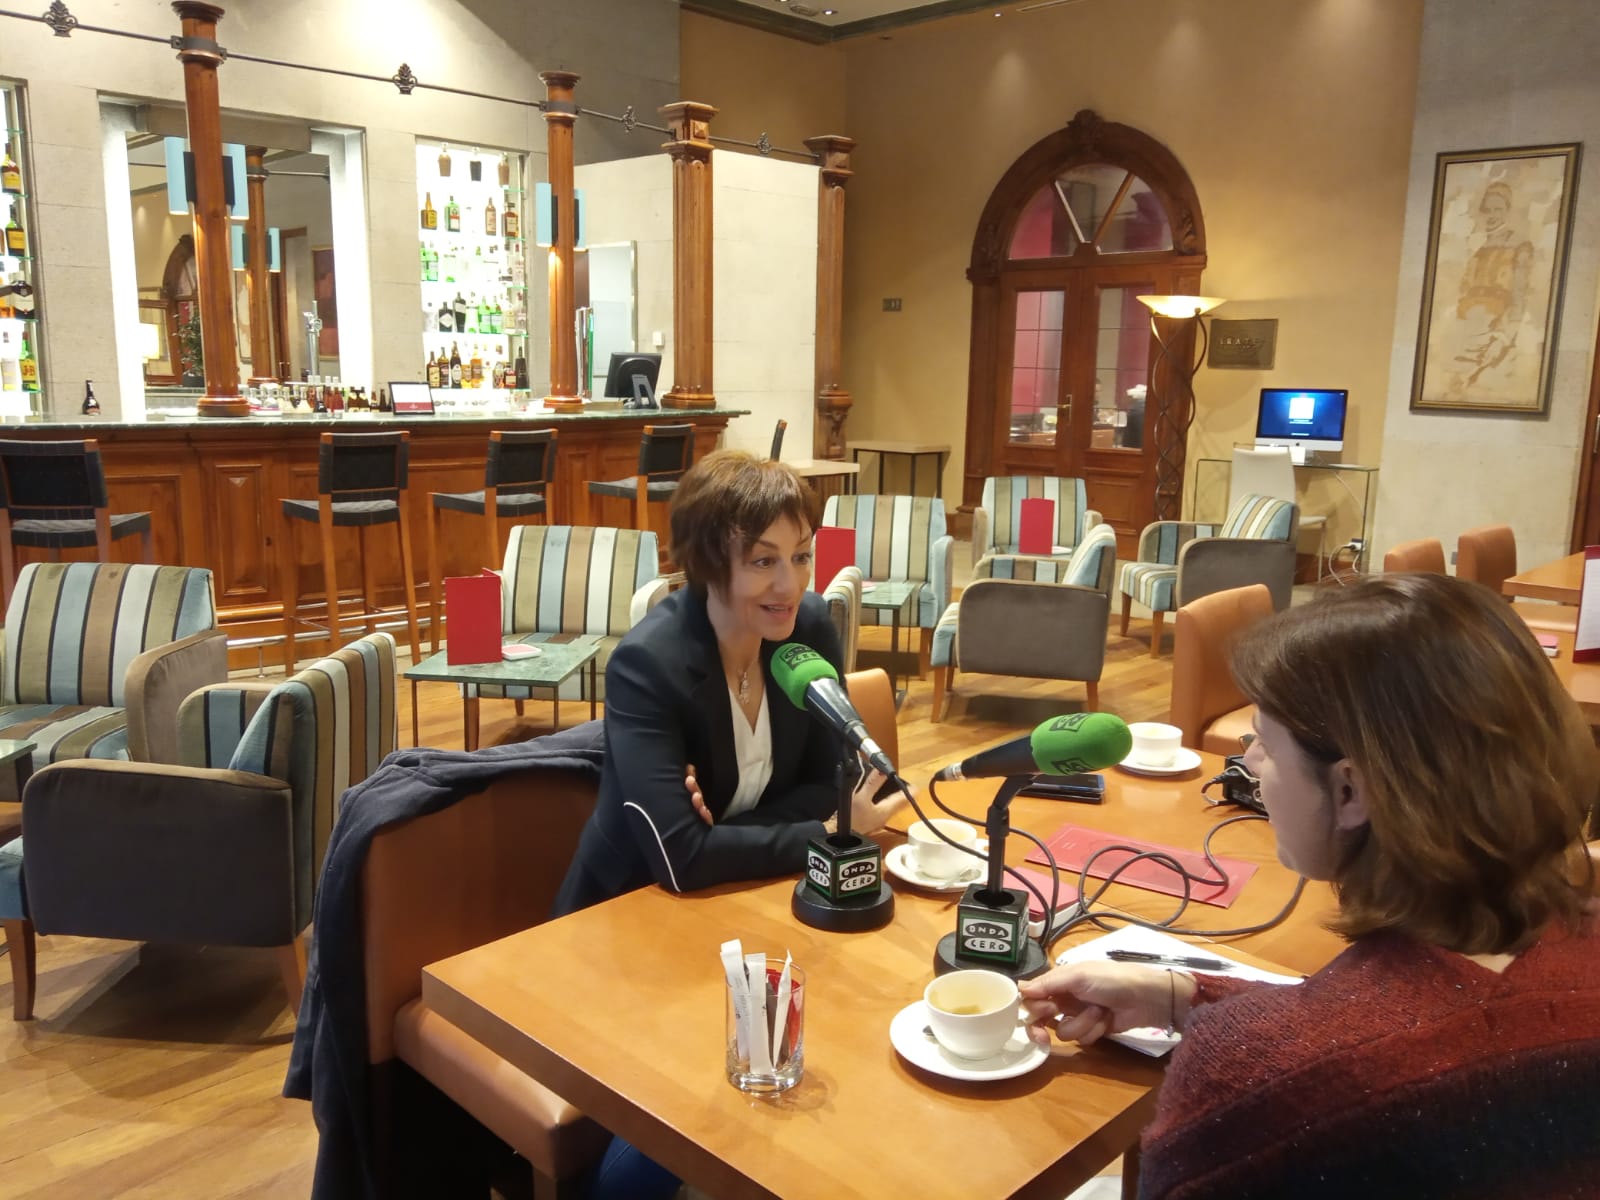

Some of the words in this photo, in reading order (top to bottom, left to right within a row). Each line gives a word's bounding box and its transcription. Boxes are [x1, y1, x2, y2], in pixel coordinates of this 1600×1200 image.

[843, 864, 873, 876] ONDA
[845, 876, 872, 888] CERO
[968, 925, 1006, 937] ONDA
[970, 940, 1005, 951] CERO
